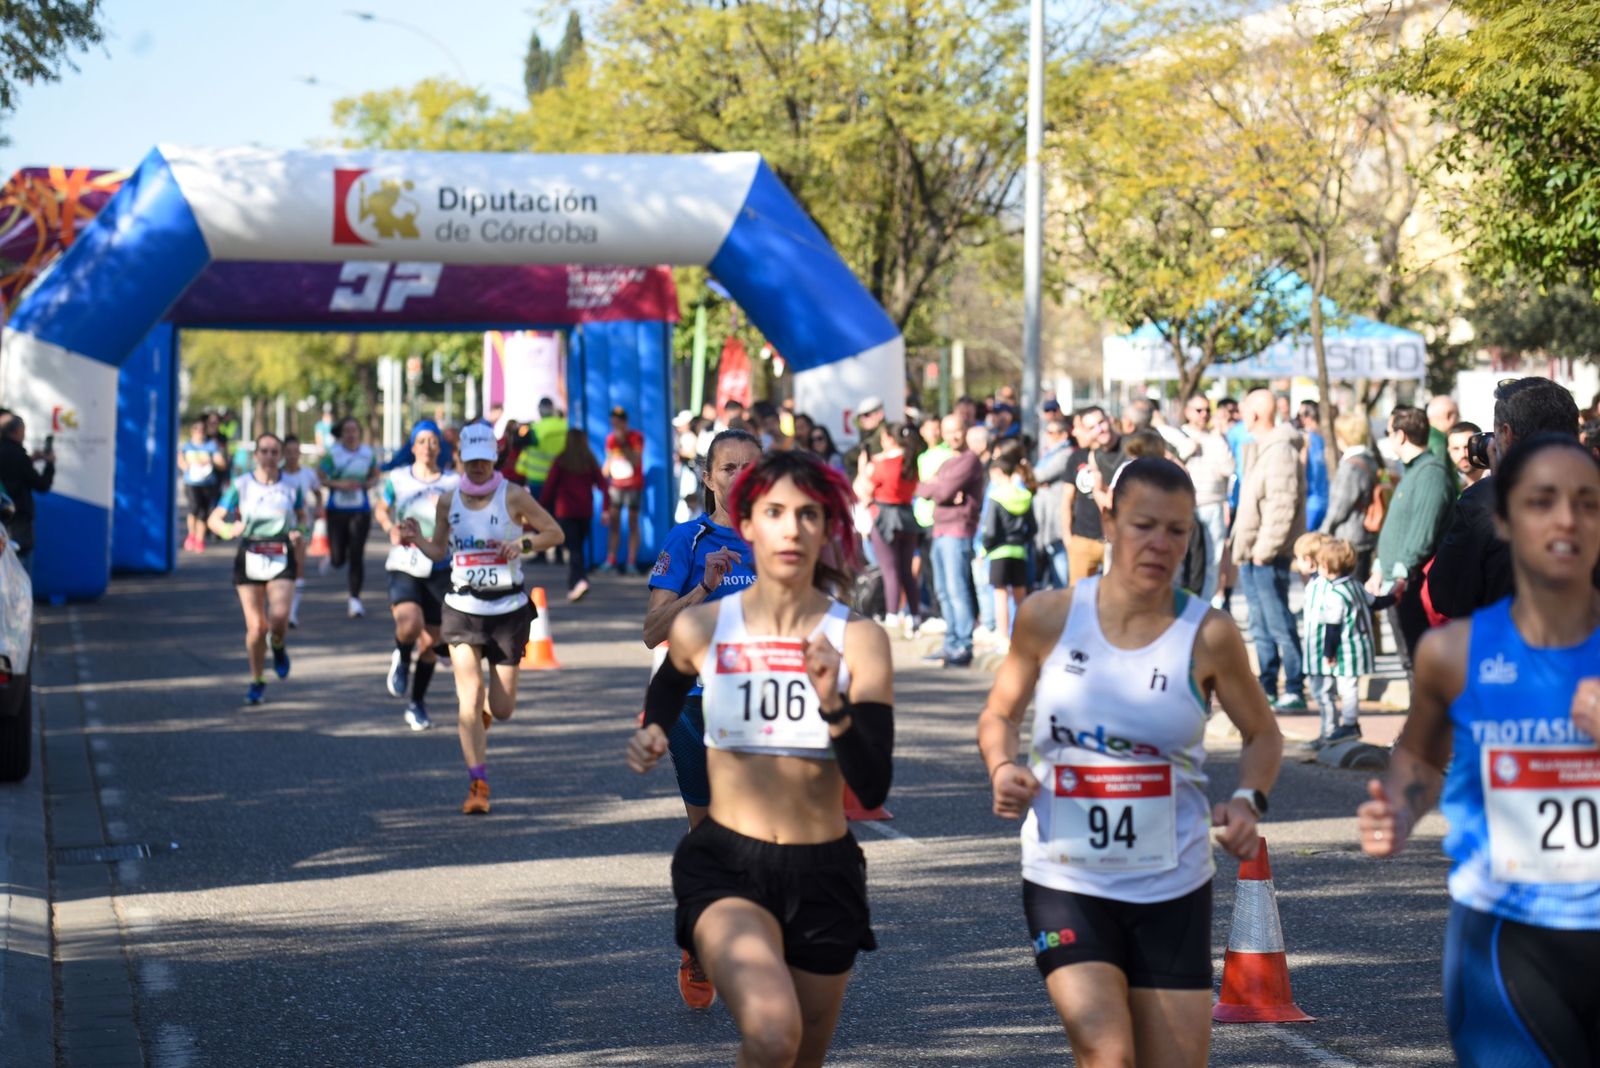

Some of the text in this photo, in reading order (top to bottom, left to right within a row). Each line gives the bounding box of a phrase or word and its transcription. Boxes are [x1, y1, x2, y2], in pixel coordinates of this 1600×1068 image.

[438, 187, 598, 217] Diputación
[435, 219, 598, 244] de Córdoba
[466, 568, 498, 588] 225
[719, 575, 757, 586] ROTAS
[738, 678, 806, 722] 106
[1088, 804, 1137, 850] 94
[1538, 797, 1600, 851] 20
